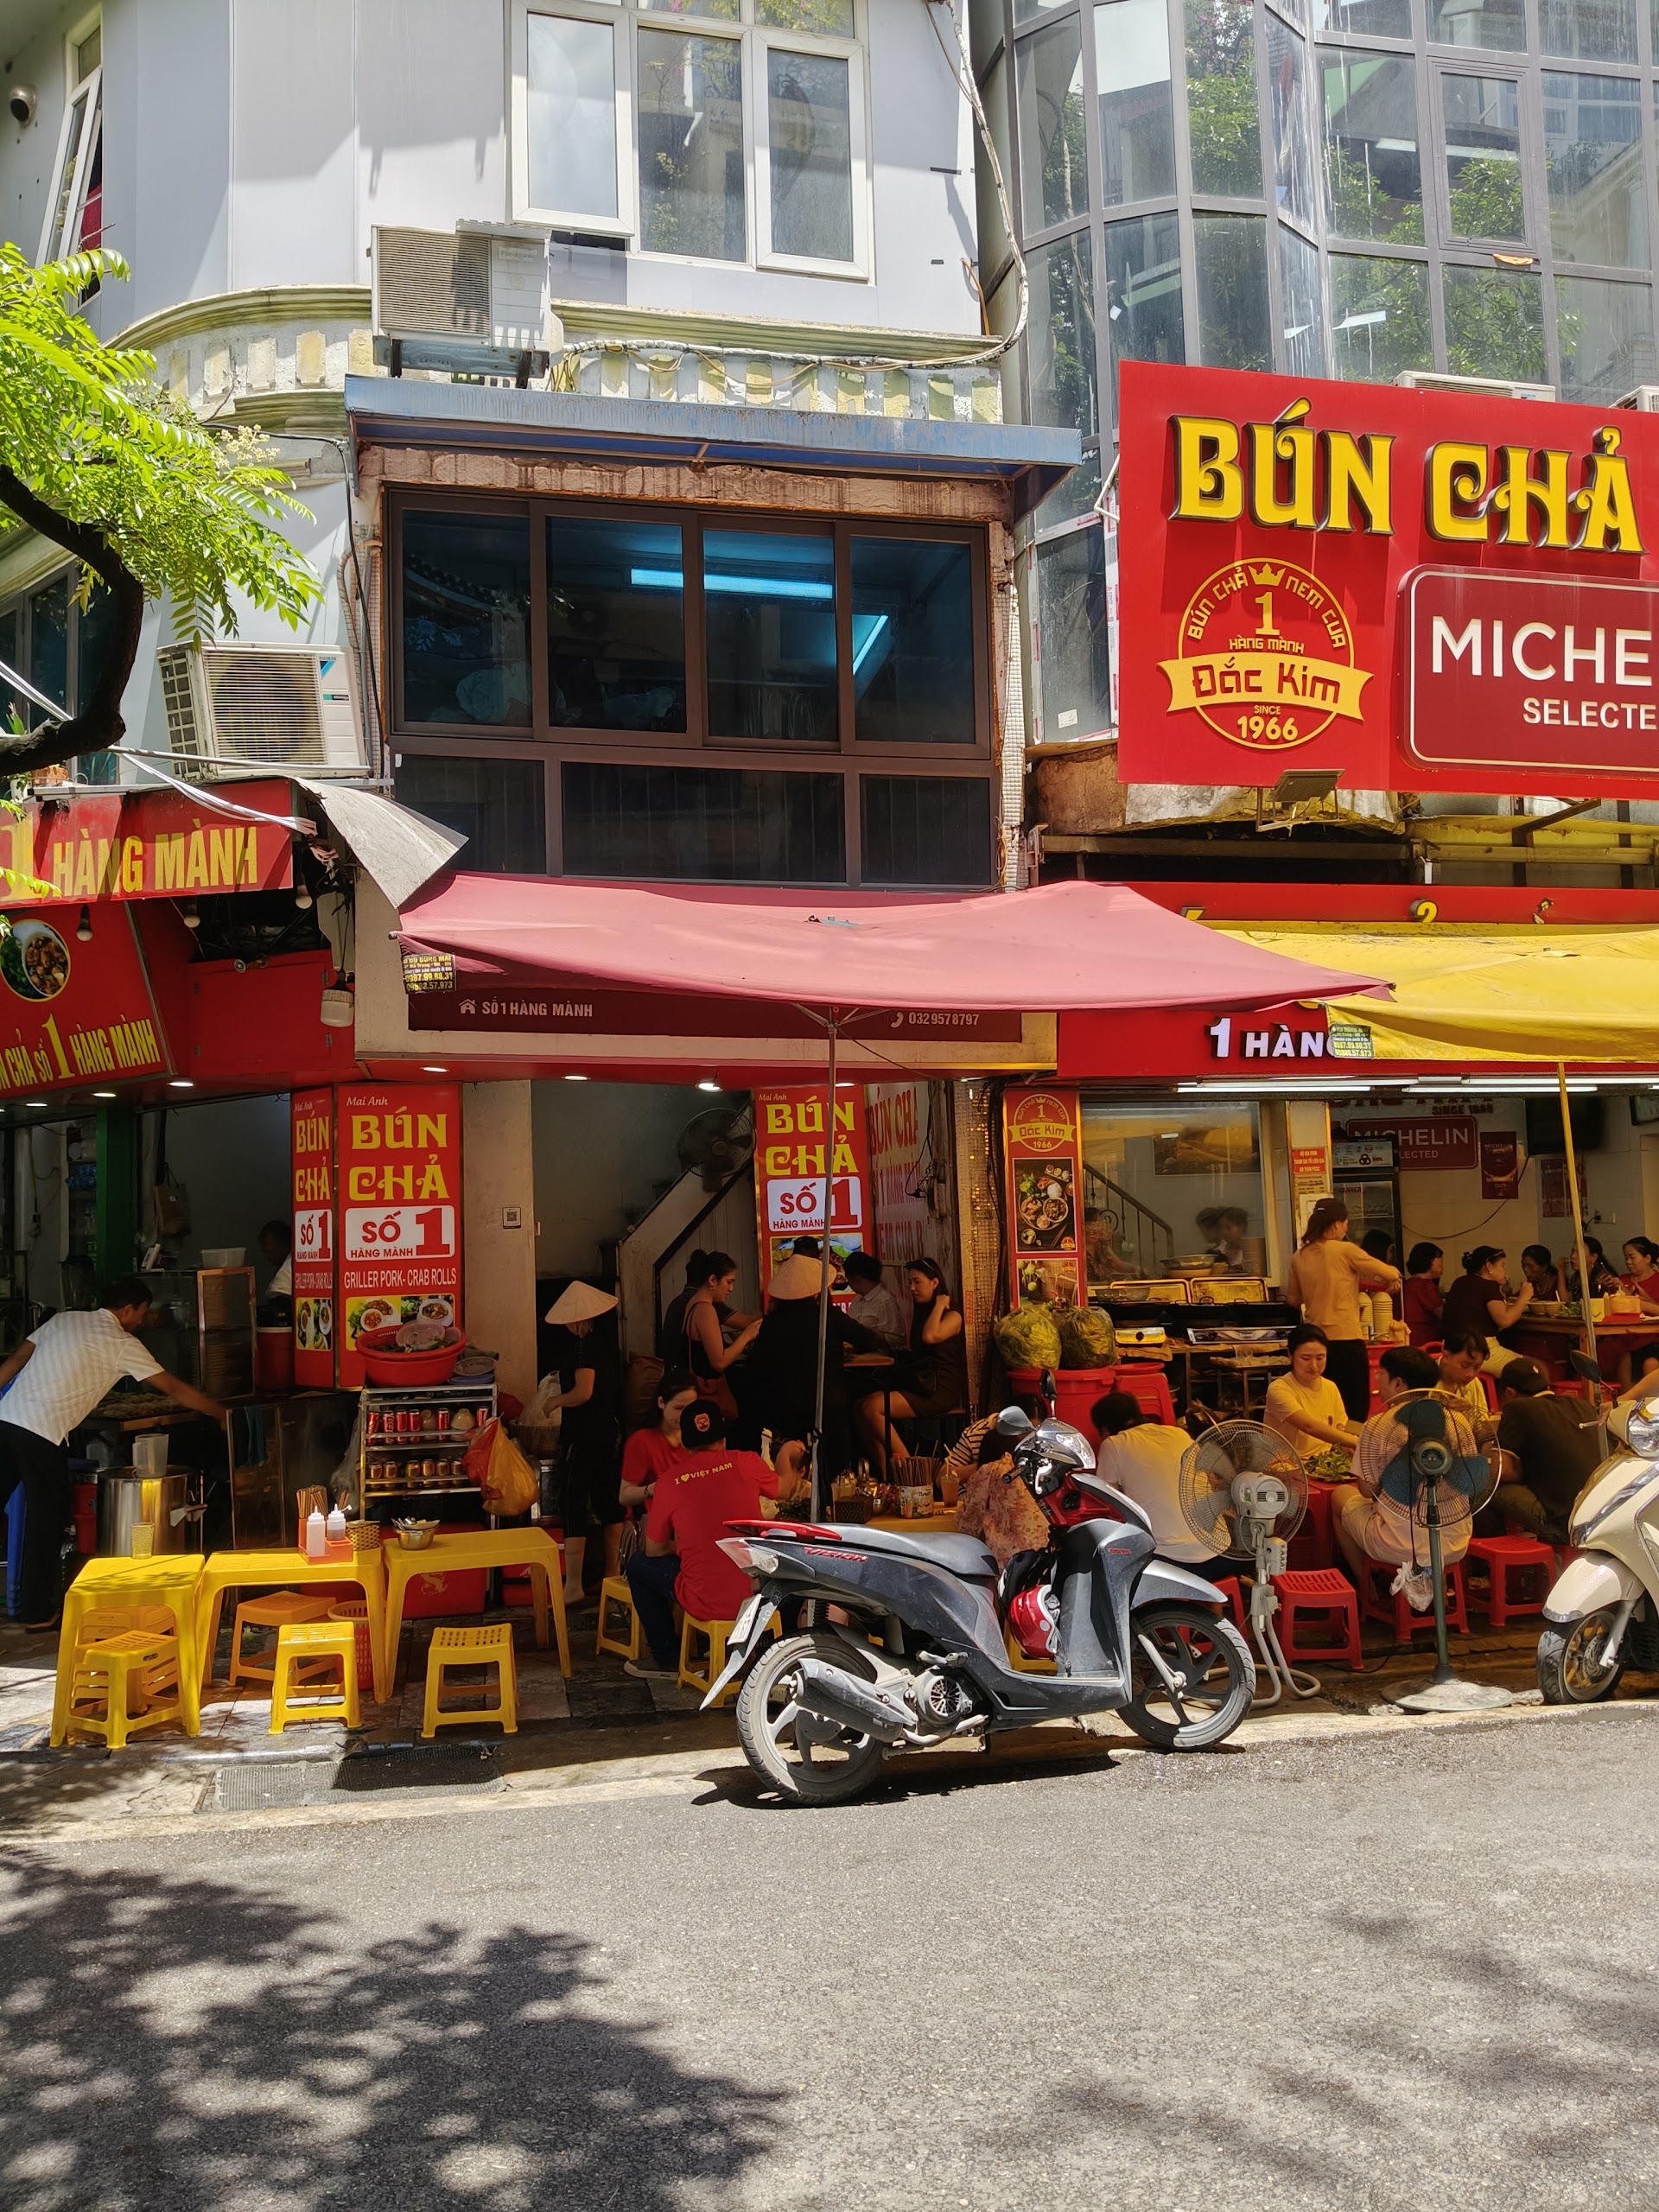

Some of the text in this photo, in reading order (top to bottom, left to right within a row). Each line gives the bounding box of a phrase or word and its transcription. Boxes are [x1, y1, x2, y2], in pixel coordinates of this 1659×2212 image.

[1167, 397, 1649, 555] BÚN CHẢ
[1187, 567, 1249, 639] BÚN CHẢ
[1255, 591, 1280, 635] 1
[1229, 634, 1305, 654] HÀNG MÀNH
[1321, 609, 1346, 648] CUA
[1432, 615, 1652, 687] MICHE
[1192, 656, 1341, 704] Đắc Kim
[1237, 716, 1298, 741] 1966
[1254, 704, 1281, 715] SINCE
[1523, 697, 1657, 730] SELECTE
[53, 828, 143, 897] HÀNG
[156, 818, 257, 890] MÀNH
[481, 996, 499, 1014] SỐ
[510, 1000, 547, 1016] HÀNG
[552, 1001, 593, 1017] MÀNH
[5, 1027, 39, 1088] CHẢ
[41, 1013, 75, 1079] 1
[69, 1023, 116, 1076] HÀNG
[109, 1014, 162, 1069] MÀNH
[1210, 1018, 1230, 1058] 1
[34, 1038, 54, 1083] SỐ
[346, 1096, 388, 1107] Mai Anh
[766, 1096, 855, 1134] BÚN
[1037, 1104, 1046, 1118] 1
[296, 1109, 329, 1154] BÚN
[351, 1105, 448, 1149] BÚN
[349, 1154, 450, 1201] CHẢ
[766, 1135, 860, 1176] CHẢ
[296, 1156, 330, 1202] CHẢ
[772, 1218, 798, 1230] HÀNG
[780, 1179, 858, 1225] SỐ 1
[301, 1211, 331, 1259] SỐ 1
[351, 1246, 413, 1258] HÀNG MÀNH
[361, 1208, 450, 1256] SỐ 1
[344, 1270, 378, 1289] GRILLER
[407, 1268, 429, 1287] CRAB
[431, 1267, 457, 1286] ROLLS
[674, 1477, 680, 1485] I
[712, 1462, 733, 1473] NAM
